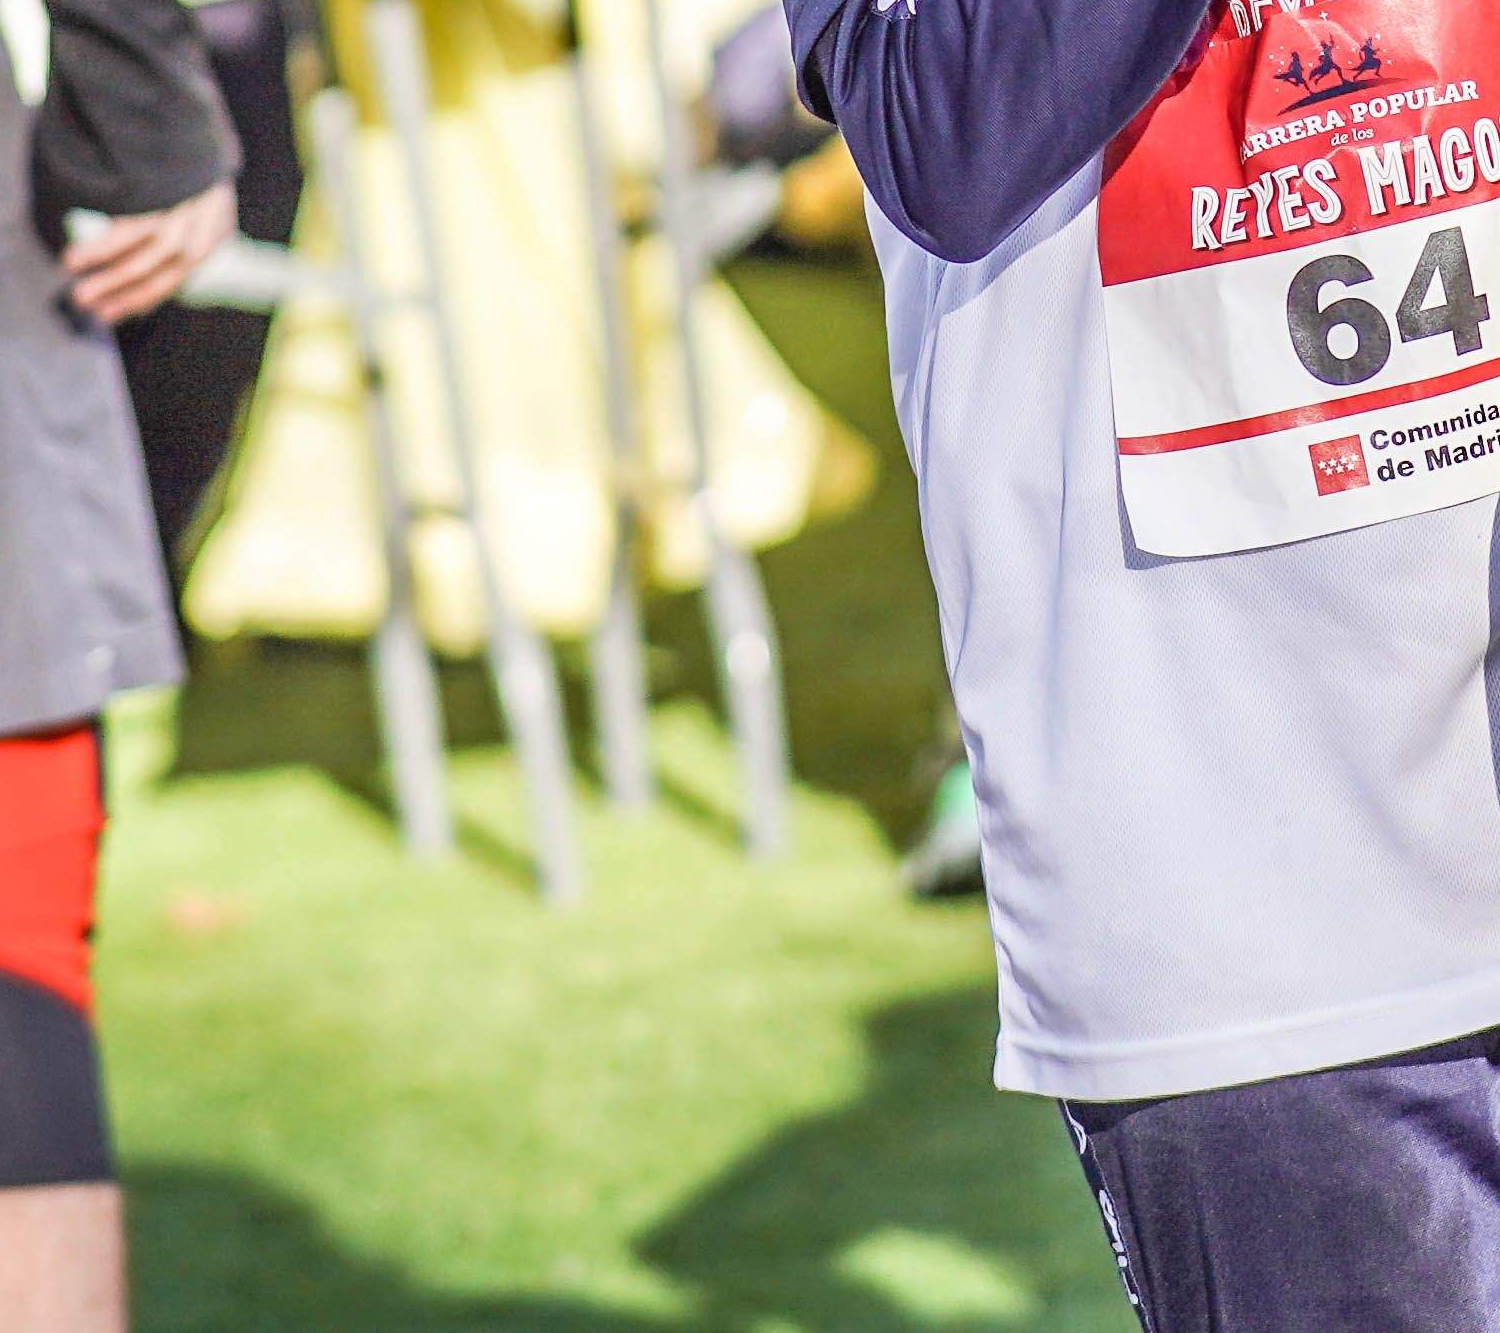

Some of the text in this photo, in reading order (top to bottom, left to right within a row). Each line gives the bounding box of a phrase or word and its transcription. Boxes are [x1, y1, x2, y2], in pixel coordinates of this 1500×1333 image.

[1241, 80, 1480, 165] ARRERA POPULAR
[1330, 128, 1374, 146] de los
[1191, 158, 1342, 251] REYES
[1287, 226, 1490, 385] 64
[1377, 459, 1414, 482] de
